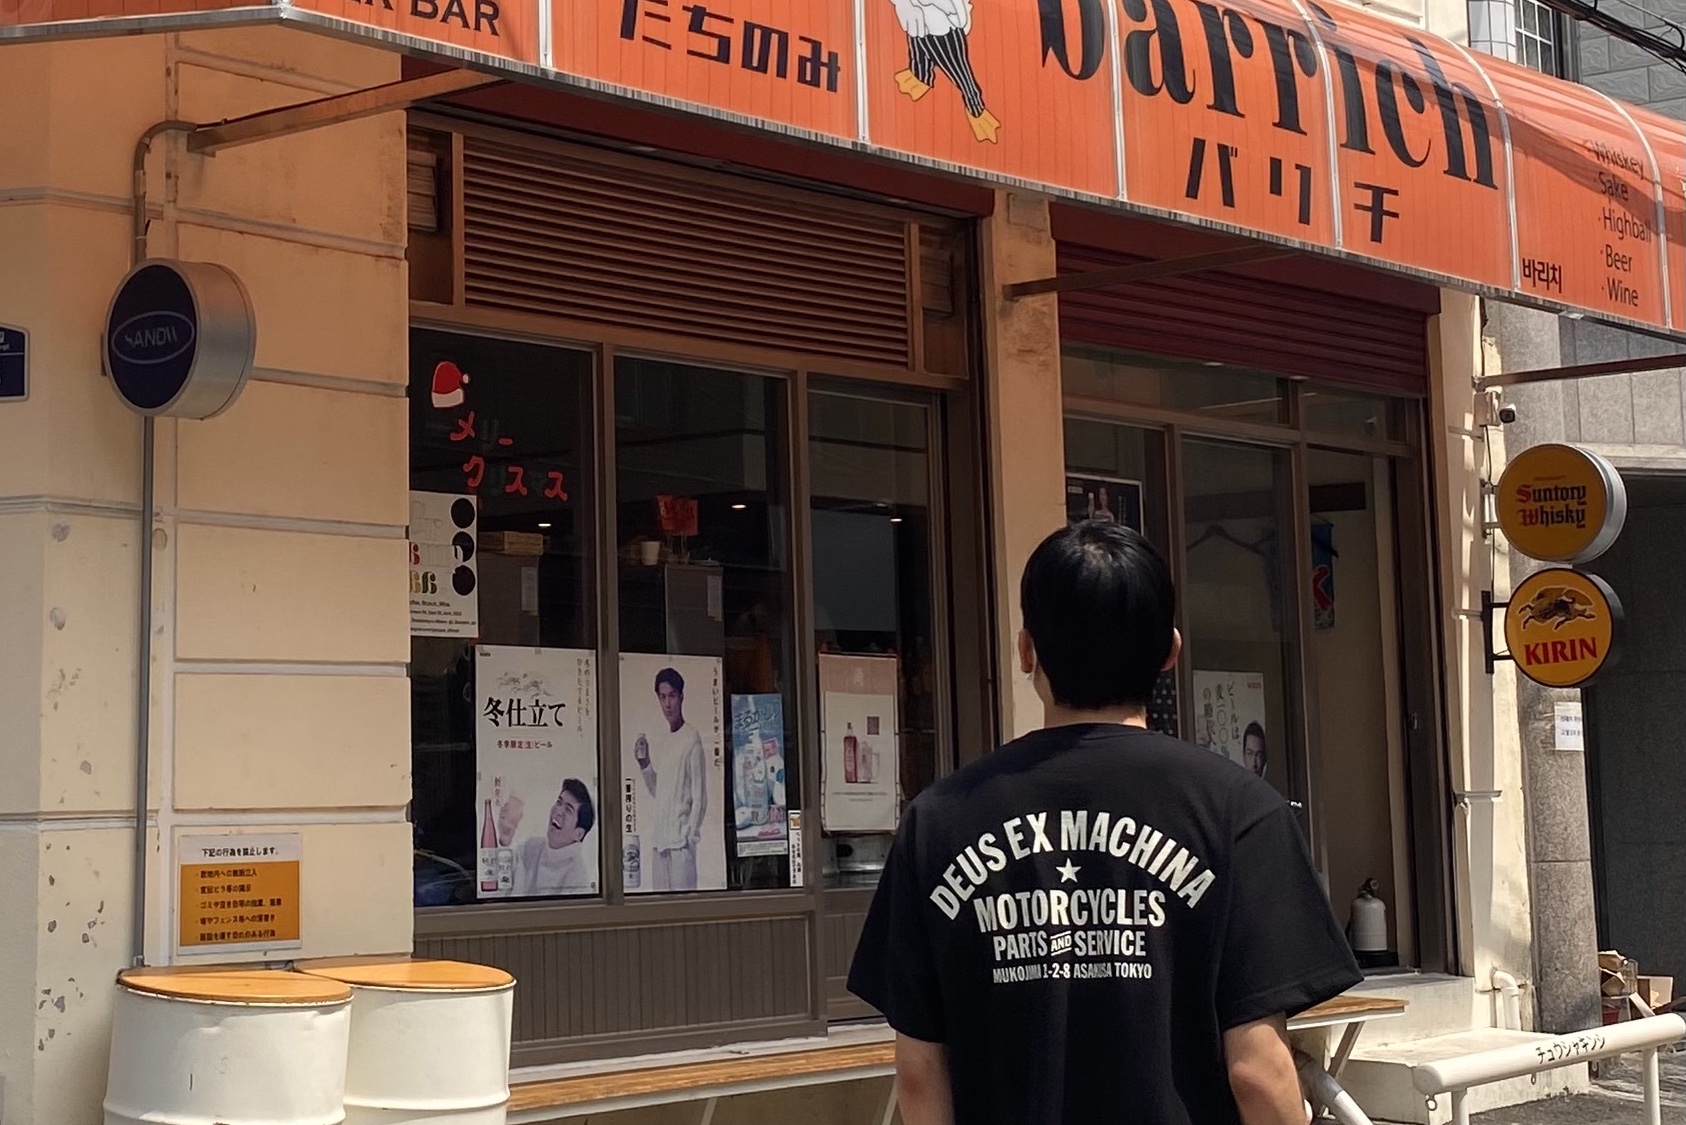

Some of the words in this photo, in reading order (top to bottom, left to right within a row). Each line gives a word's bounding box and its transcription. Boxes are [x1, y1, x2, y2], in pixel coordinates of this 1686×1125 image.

[410, 0, 500, 37] BAR
[620, 0, 841, 93] たちのみ
[1184, 136, 1401, 244] バリチ
[1598, 171, 1629, 201] Sake
[1602, 206, 1653, 244] Highball
[1605, 243, 1633, 274] Beer
[1522, 257, 1562, 294] 바리치
[1606, 276, 1639, 308] Wine
[1516, 483, 1588, 506] Suntory
[1517, 503, 1587, 529] Whisky
[1524, 637, 1598, 666] KIRIN
[483, 697, 567, 728] 冬仕立て
[929, 832, 1008, 920] DEUS
[1003, 812, 1054, 860] EX
[1060, 810, 1217, 909] MACHINA
[973, 887, 1166, 933] MOTORCYCLES
[993, 930, 1048, 961] PARTS
[1050, 932, 1073, 955] AND
[1074, 930, 1147, 957] SERVICE
[1043, 962, 1071, 980] 1-2-8
[1114, 961, 1152, 979] TOKYO
